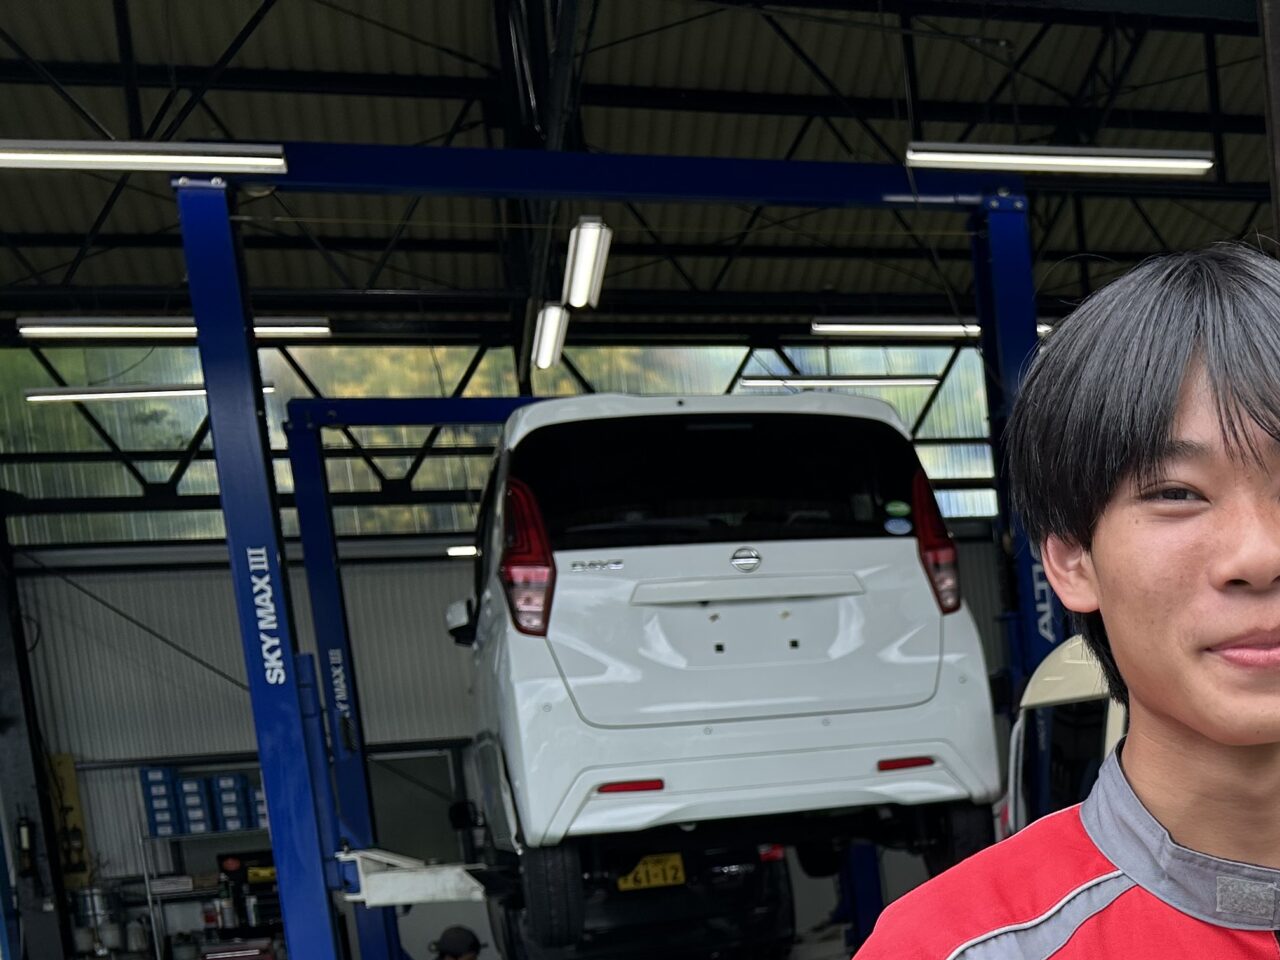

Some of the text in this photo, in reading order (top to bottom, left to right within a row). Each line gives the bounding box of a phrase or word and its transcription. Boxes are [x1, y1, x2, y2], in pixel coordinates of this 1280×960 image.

[247, 546, 286, 685] SKY MAX III
